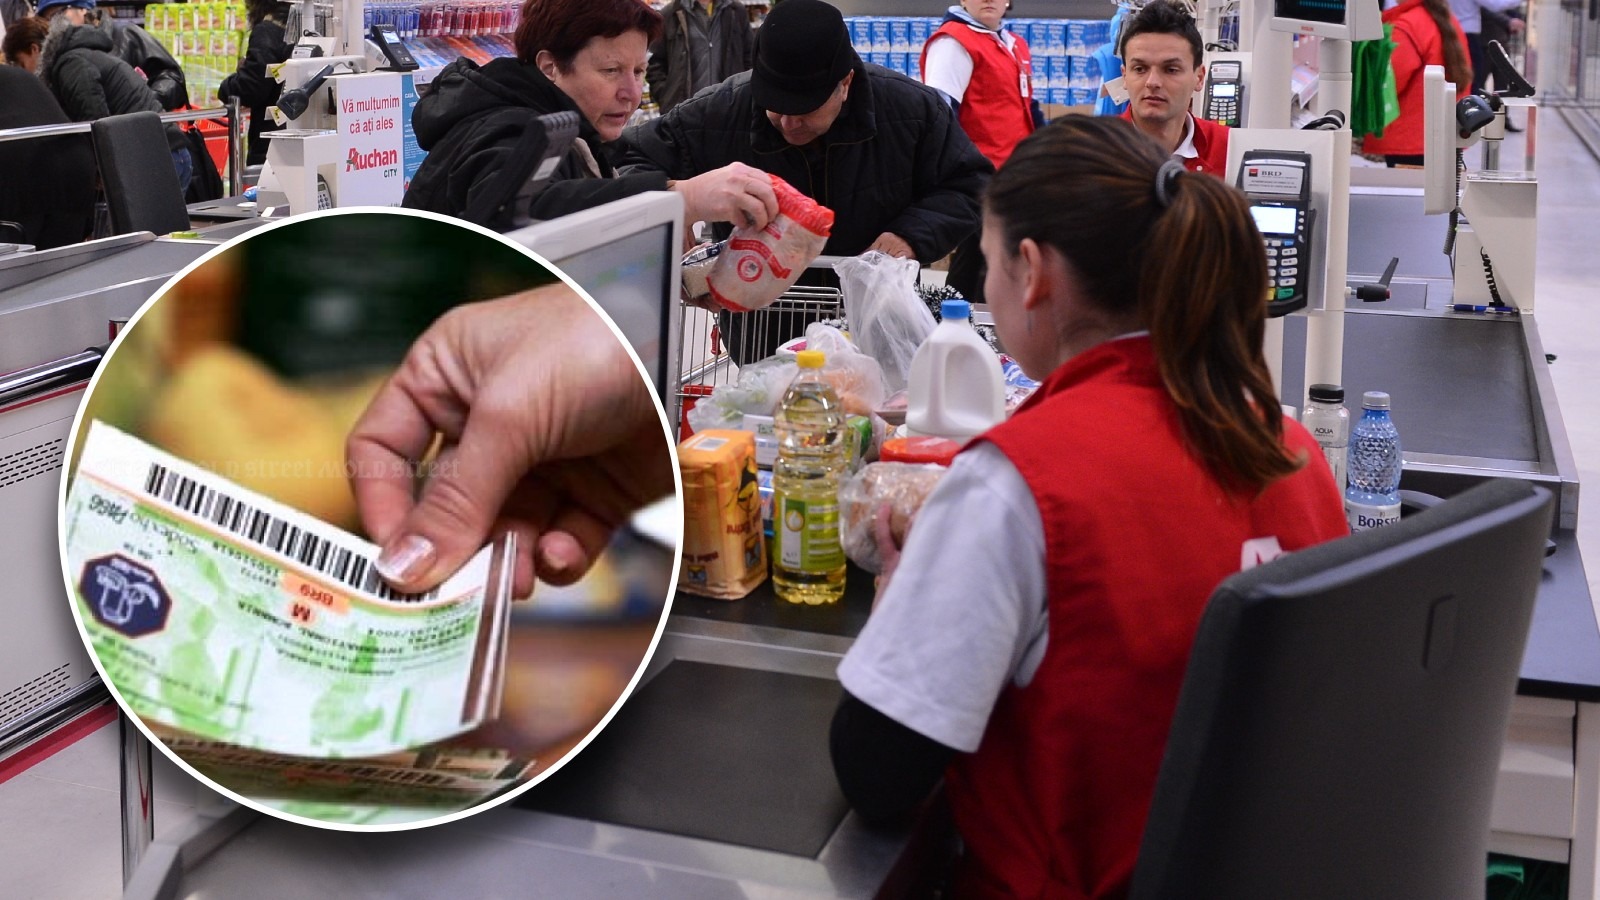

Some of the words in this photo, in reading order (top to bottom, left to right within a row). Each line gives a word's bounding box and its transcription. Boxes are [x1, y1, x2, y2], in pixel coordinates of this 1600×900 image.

[341, 99, 354, 113] Vă
[349, 119, 361, 134] că
[376, 117, 394, 130] ales
[346, 147, 398, 172] Auchan
[383, 168, 398, 178] CITY
[291, 603, 311, 622] M
